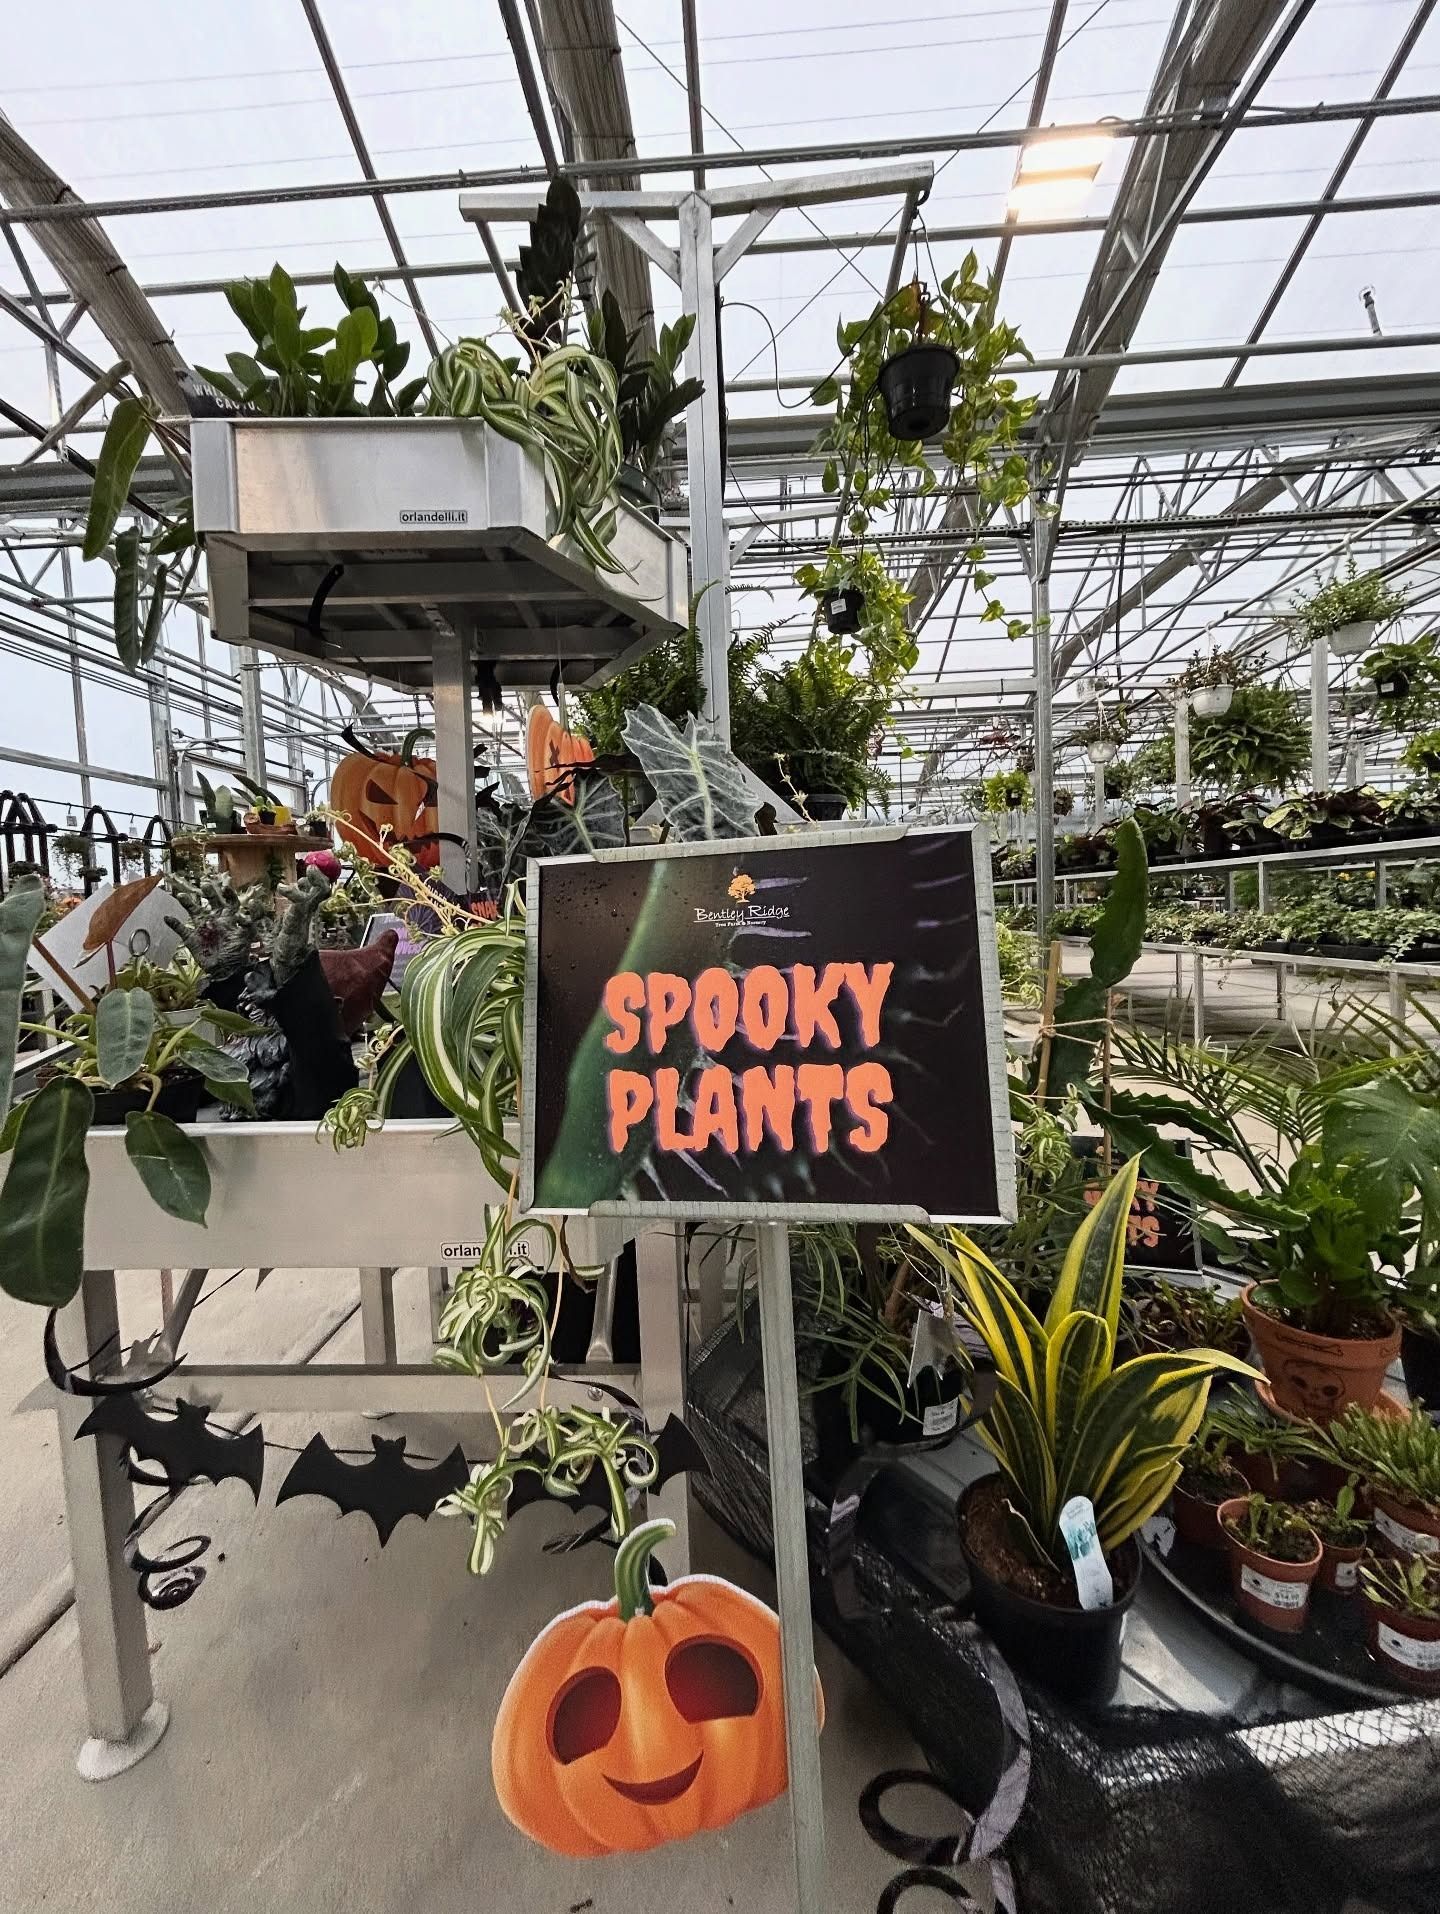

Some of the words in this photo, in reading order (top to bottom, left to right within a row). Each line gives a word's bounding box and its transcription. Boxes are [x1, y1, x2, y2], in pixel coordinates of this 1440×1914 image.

[402, 511, 465, 522] orlandelli.it
[694, 907, 745, 923] Bentley
[748, 904, 790, 919] Ridge
[604, 962, 894, 1053] SPOOKY
[608, 1062, 894, 1154] PLANTS
[443, 1243, 527, 1257] orlani.it
